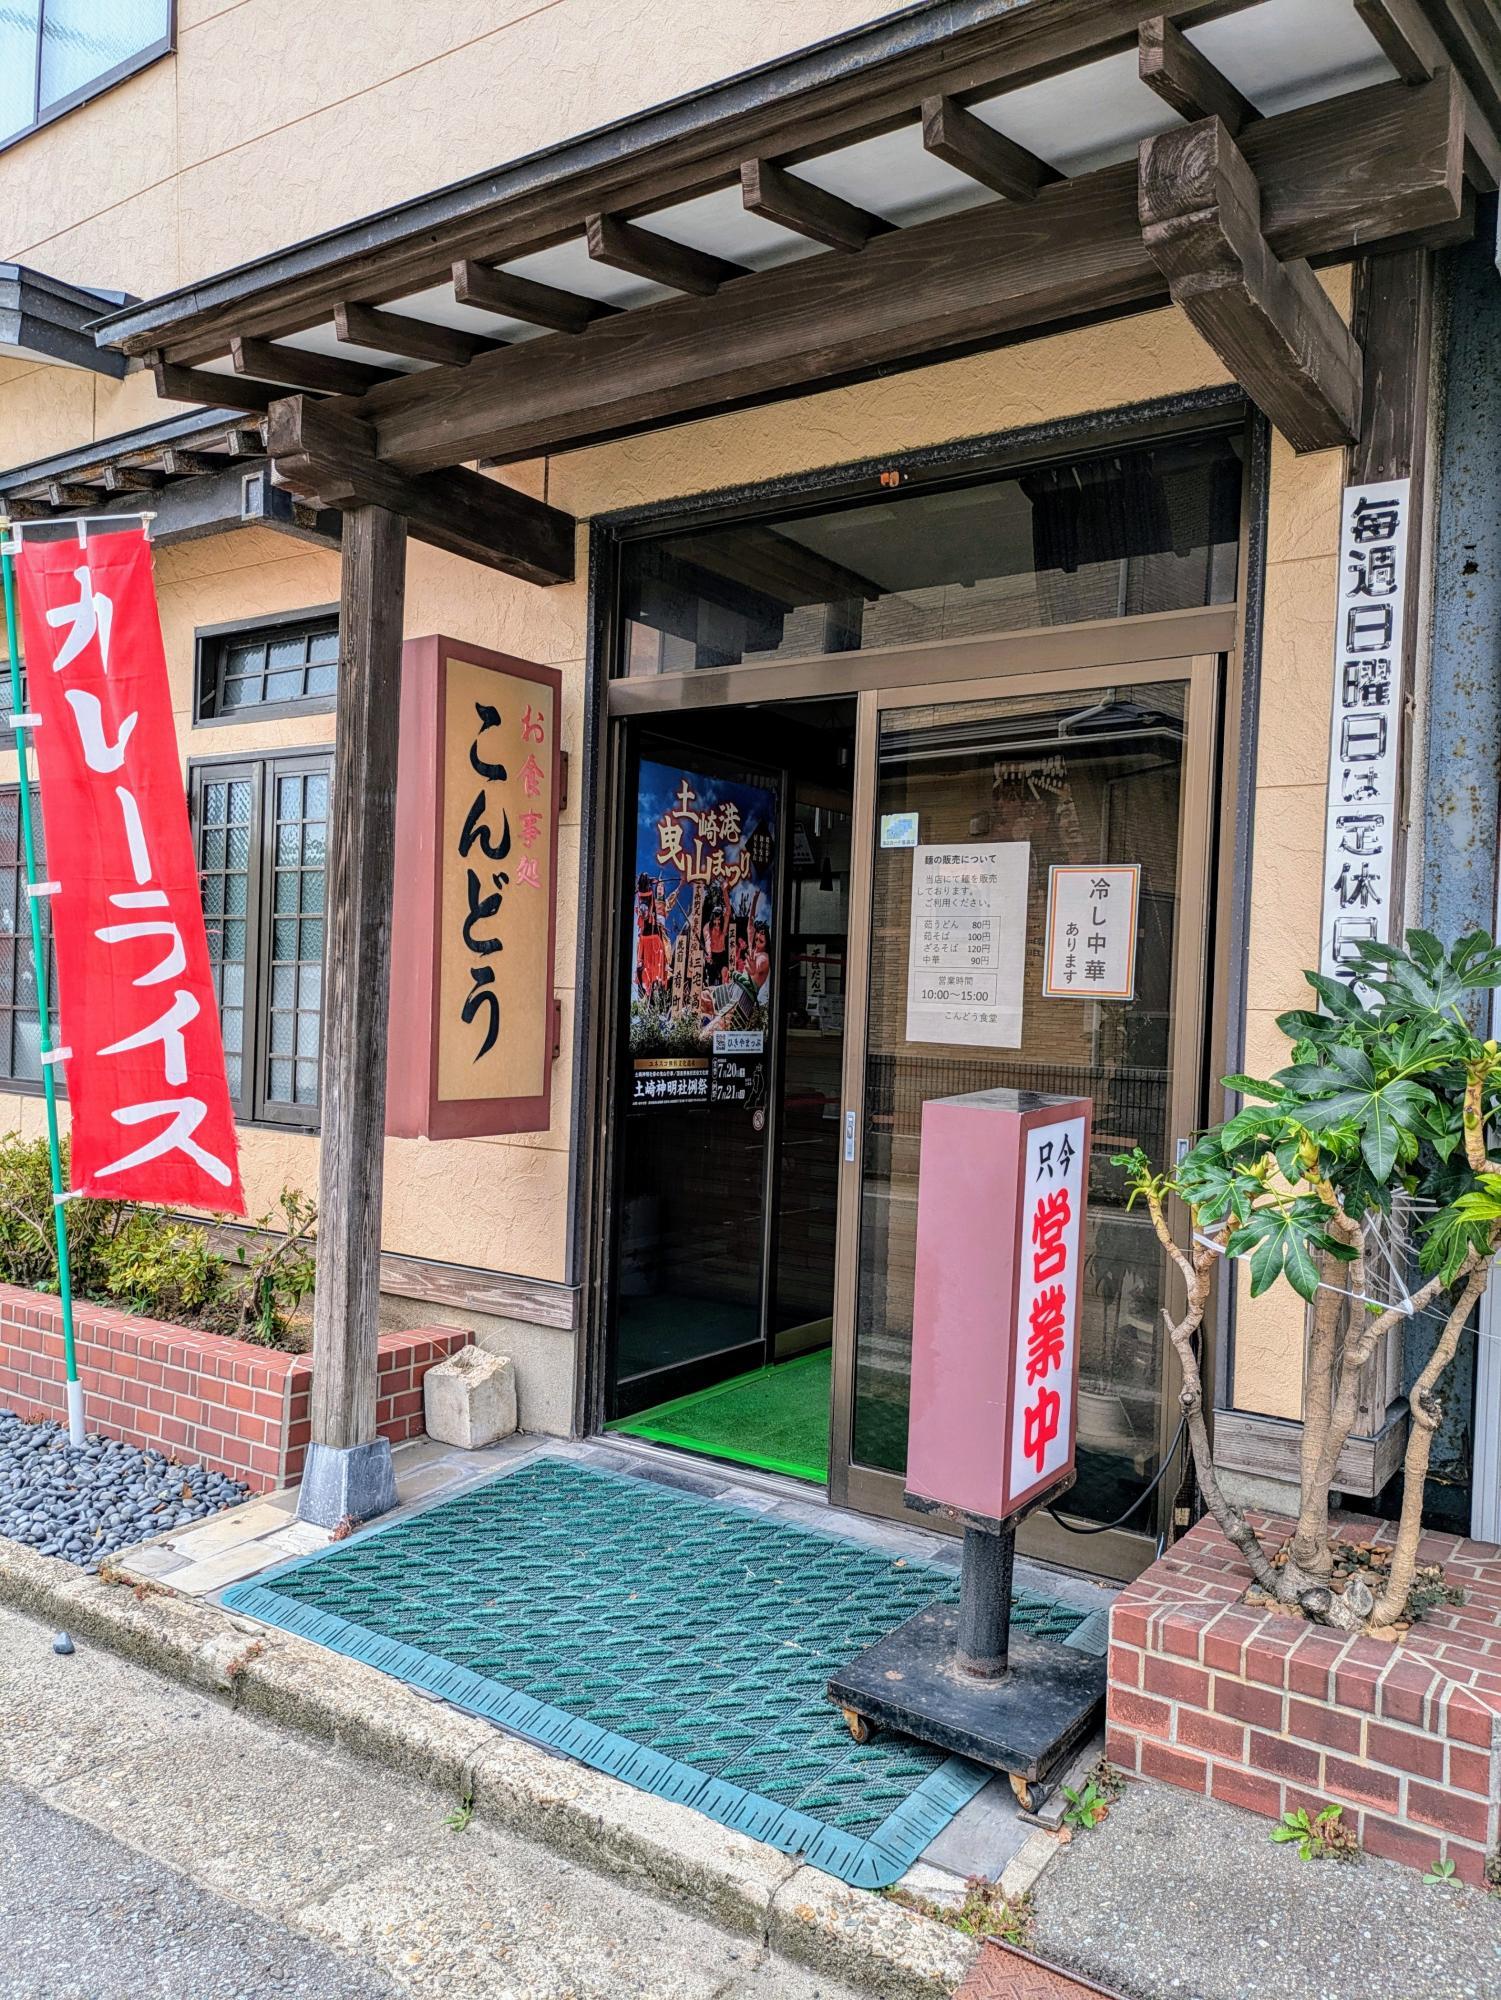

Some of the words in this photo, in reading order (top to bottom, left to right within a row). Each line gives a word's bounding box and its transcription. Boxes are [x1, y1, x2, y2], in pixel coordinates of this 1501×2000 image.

[515, 703, 546, 889] お食事処
[672, 779, 741, 847] 土崎港
[656, 815, 751, 888] 曳山まつり
[924, 854, 997, 865] 麺の販売について
[46, 566, 233, 1188] カレーライス
[458, 701, 512, 1065] こんどう
[925, 874, 998, 884] 当店にて麺を販売
[917, 886, 974, 897] しております。
[924, 898, 992, 909] ご利用ください。
[972, 920, 991, 930] 80円
[1084, 877, 1111, 982] 冷し中華
[968, 931, 991, 942] 100円
[923, 943, 959, 953] ざるそば
[967, 943, 991, 954] 120円
[1063, 921, 1080, 985] あります
[923, 955, 940, 965] 中華
[970, 956, 990, 966] 90円
[938, 975, 974, 986] 営業時間
[921, 989, 989, 1002] 10:00〜15:00
[944, 1011, 998, 1024] こんどう食堂
[633, 1077, 709, 1098] 土崎神明社例祭
[1035, 1132, 1076, 1184] 只今
[1023, 1187, 1071, 1474] 営業中
